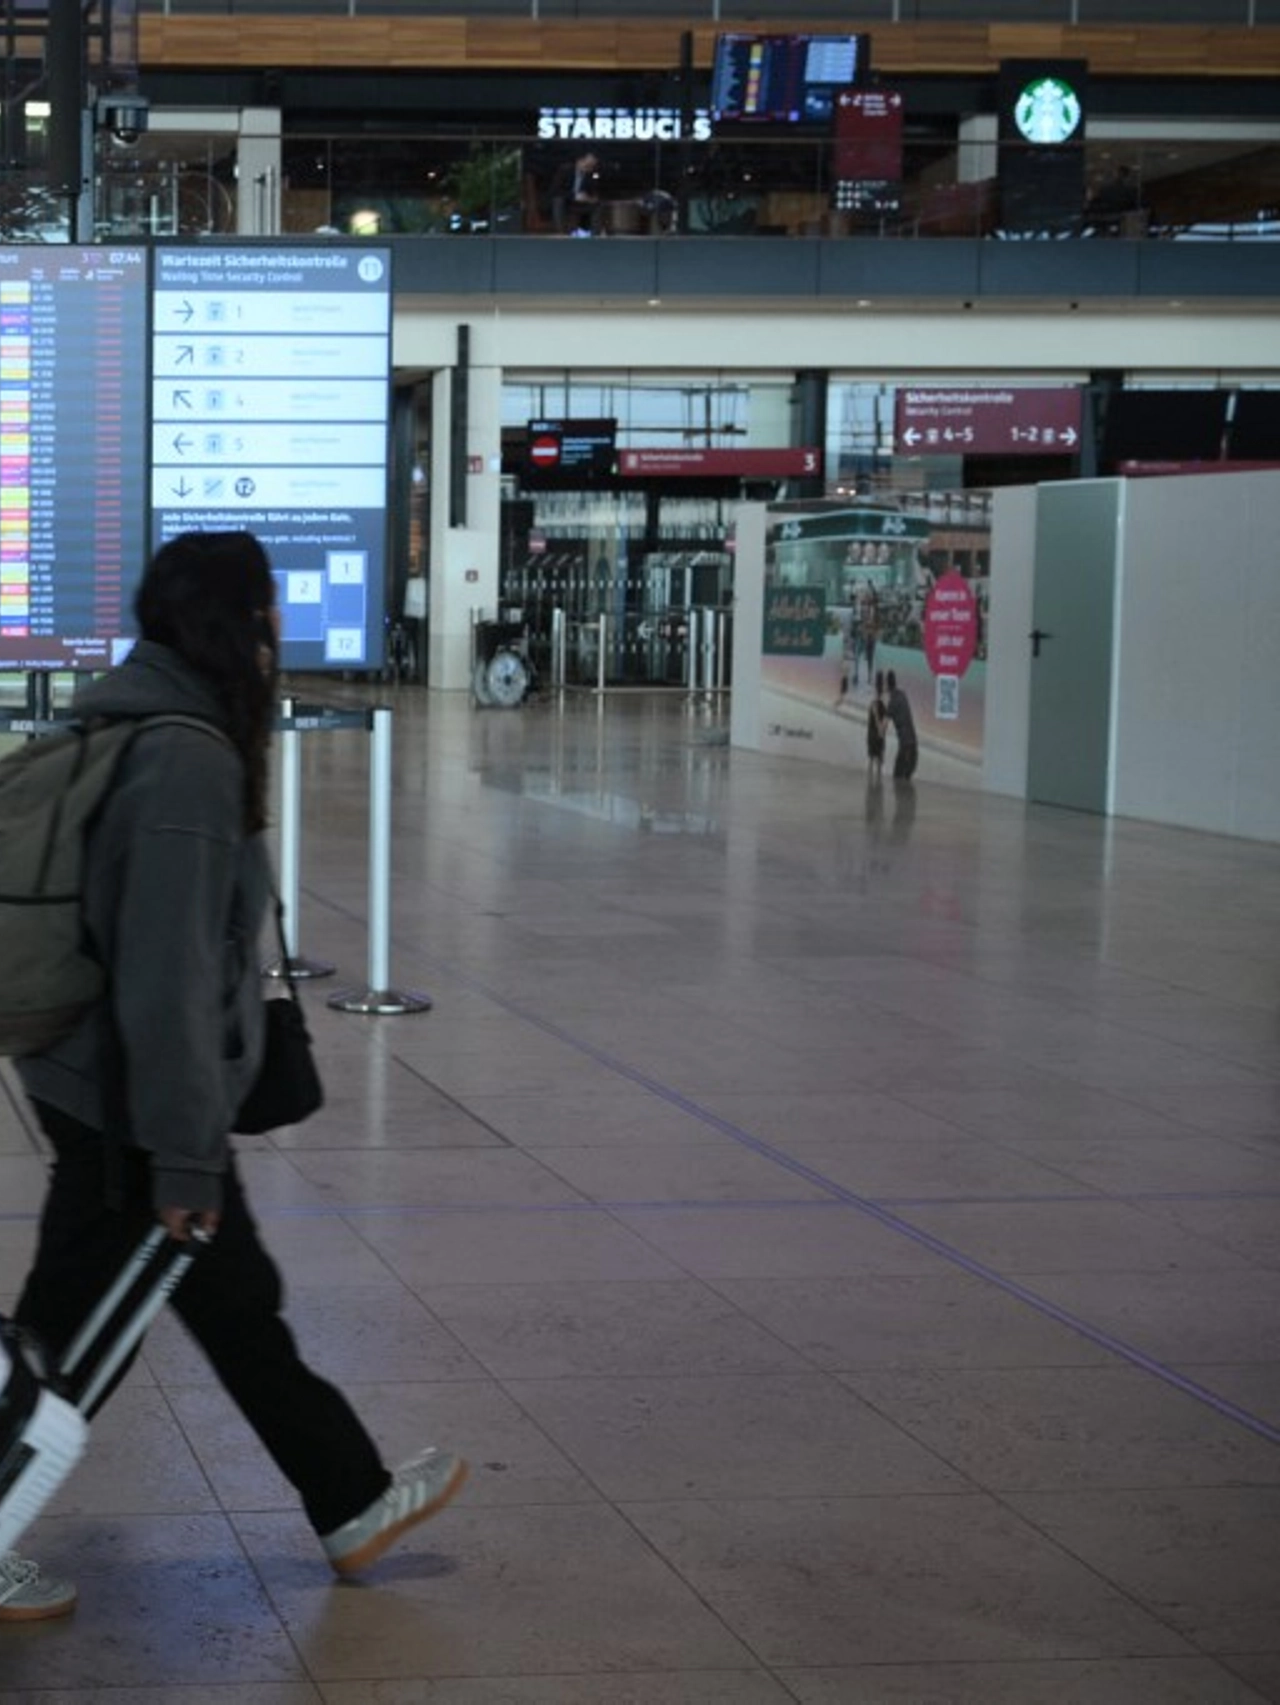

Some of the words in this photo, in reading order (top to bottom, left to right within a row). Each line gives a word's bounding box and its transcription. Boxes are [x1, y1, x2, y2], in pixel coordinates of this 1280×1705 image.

[161, 255, 221, 267] Wartezeit
[224, 254, 348, 268] Sicherheitskontrolle
[161, 272, 198, 283] Waiting
[200, 271, 223, 282] Time
[226, 271, 265, 284] Security
[267, 272, 303, 282] Control
[905, 392, 1014, 404] Sicherheitskontrolle
[905, 406, 939, 417] Security
[803, 454, 815, 471] 3
[300, 581, 308, 595] 2
